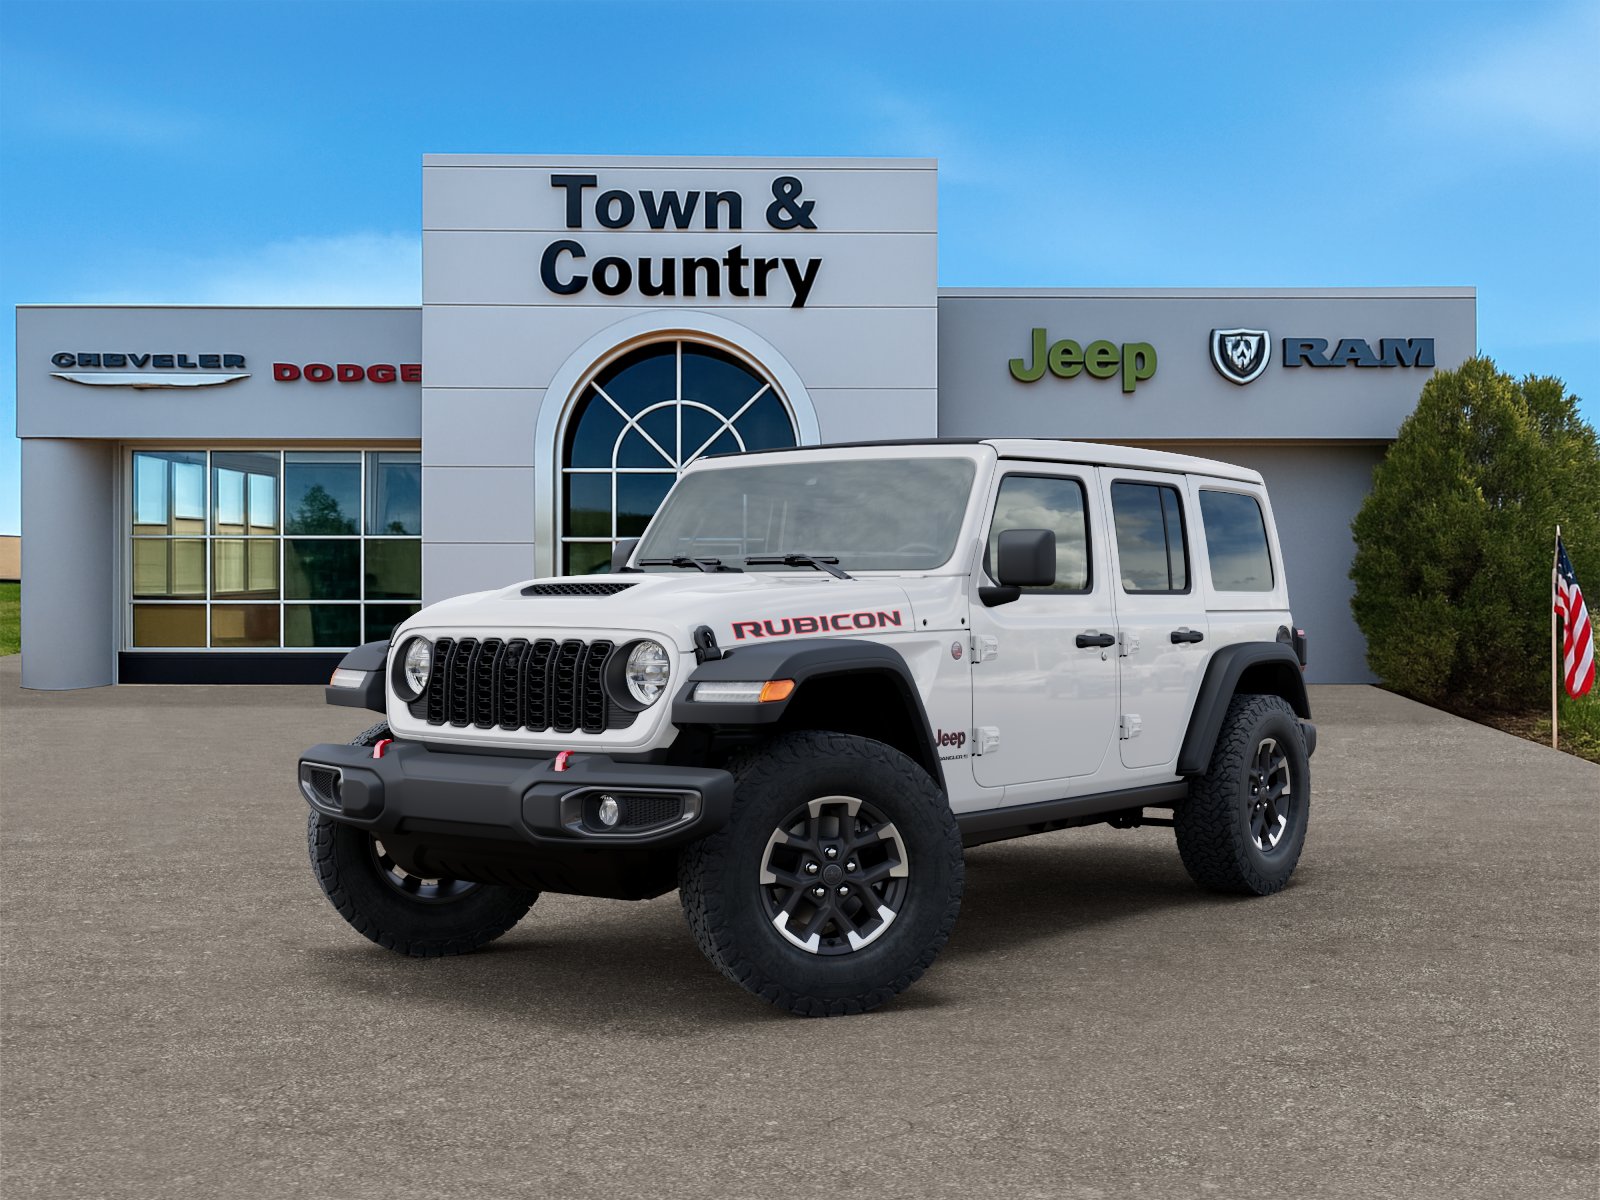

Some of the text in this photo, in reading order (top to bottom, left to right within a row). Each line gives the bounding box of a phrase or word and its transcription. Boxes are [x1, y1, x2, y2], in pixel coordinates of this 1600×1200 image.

[550, 174, 818, 230] Town &
[539, 239, 822, 308] Country
[1008, 327, 1158, 393] Jeep
[1282, 337, 1436, 368] RAM
[272, 362, 422, 383] DODGE
[731, 610, 902, 640] RUBICON
[935, 729, 966, 749] Jeep
